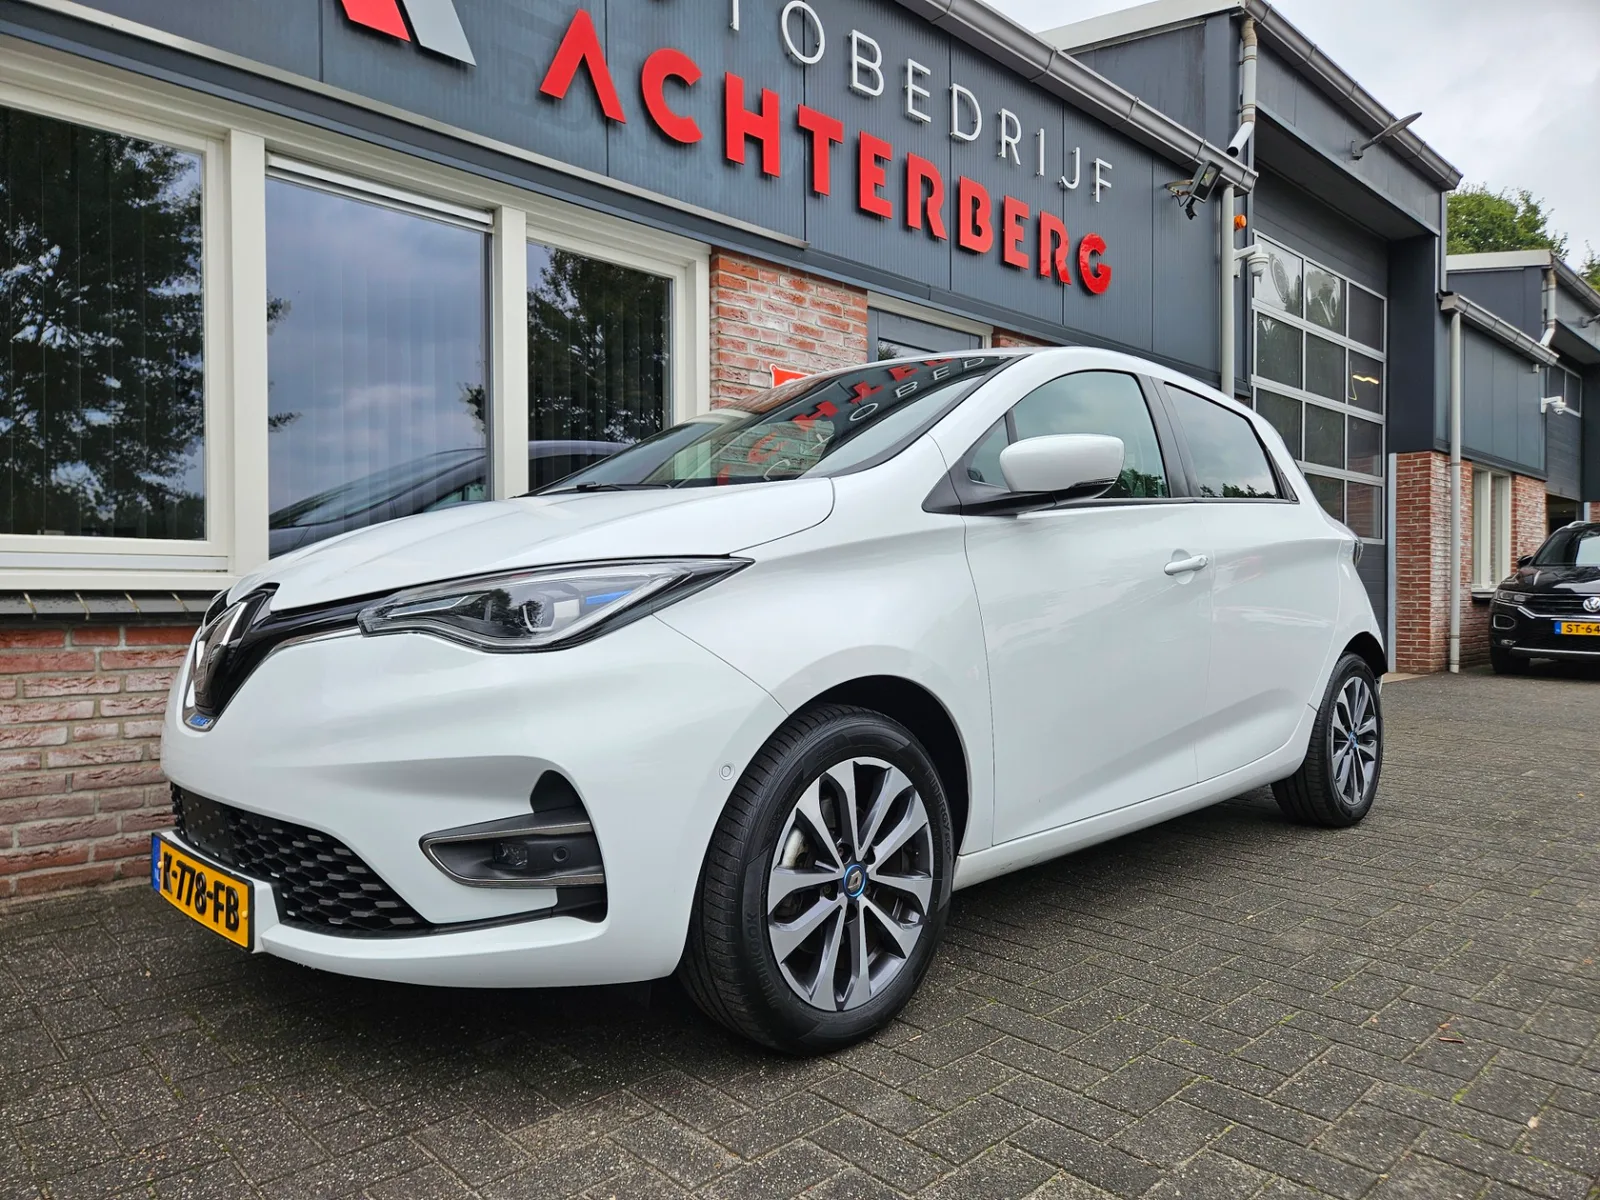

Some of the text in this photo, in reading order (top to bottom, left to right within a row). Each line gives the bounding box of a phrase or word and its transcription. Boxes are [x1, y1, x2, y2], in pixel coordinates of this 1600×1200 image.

[539, 8, 1112, 295] ACHTERBERG
[1566, 624, 1600, 634] ST-64
[163, 851, 240, 932] K-778-FB
